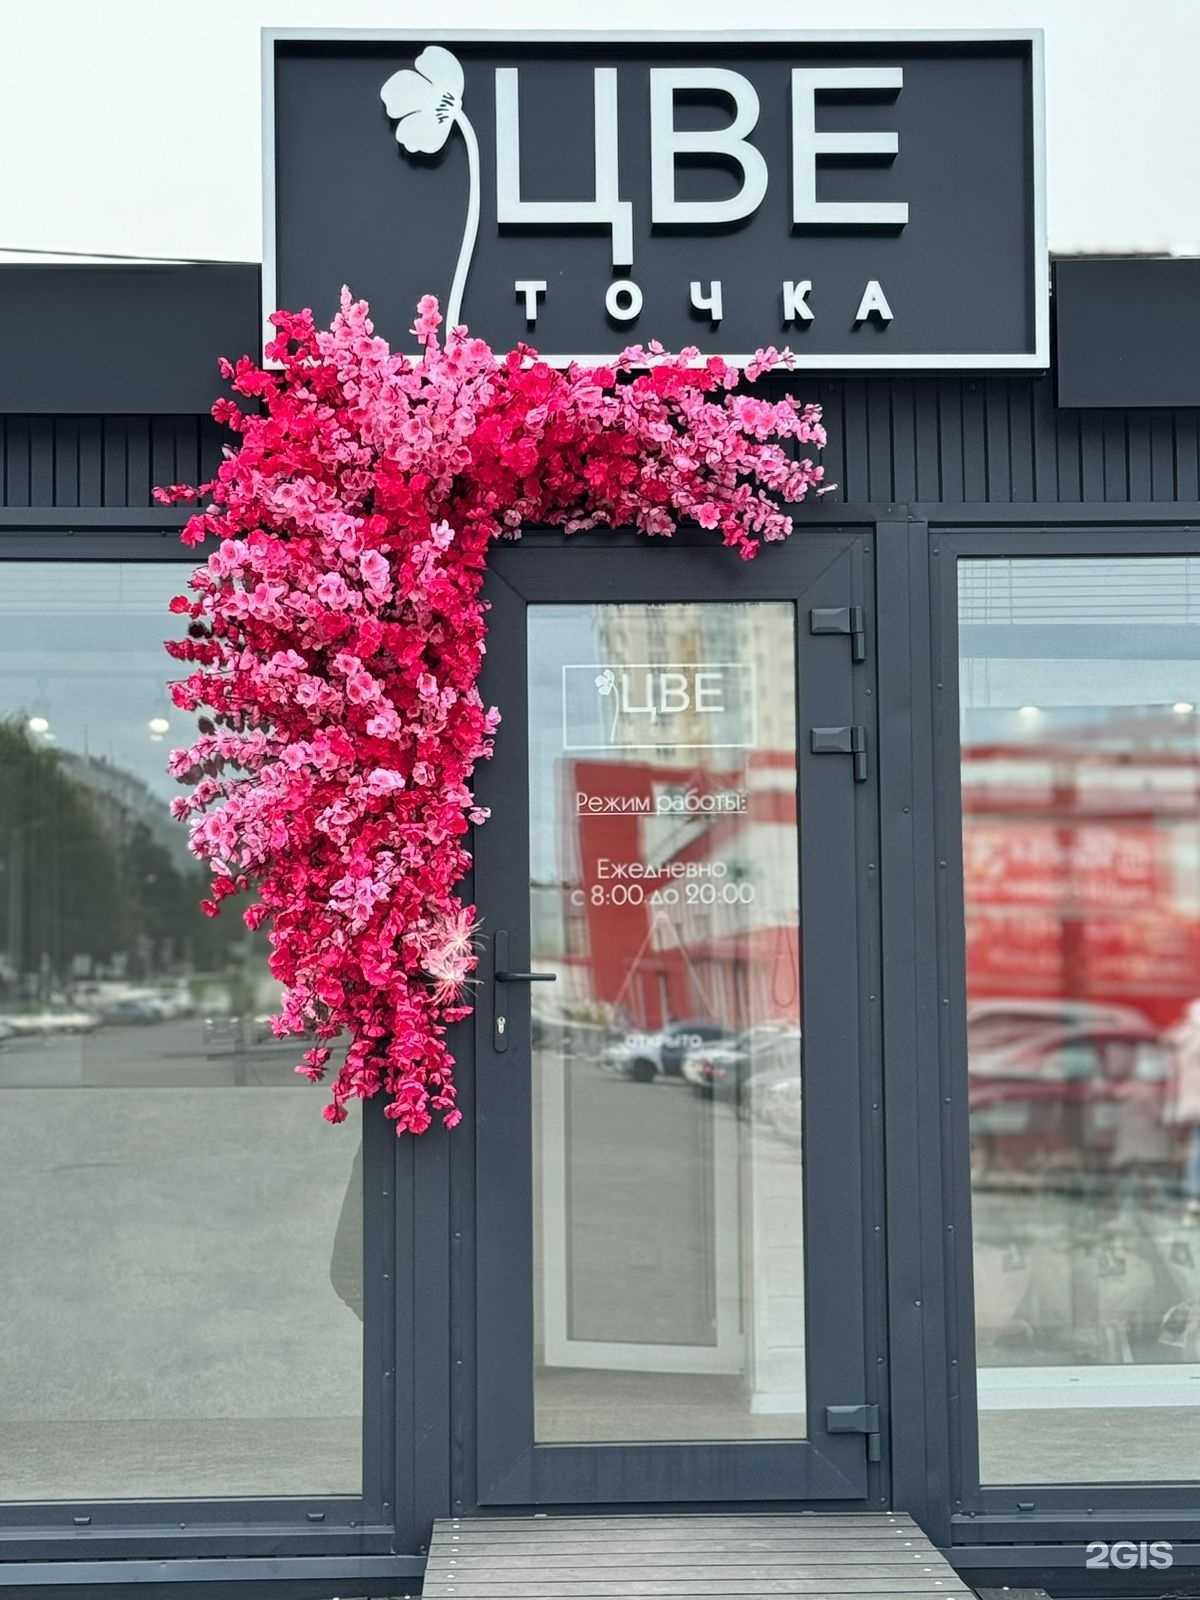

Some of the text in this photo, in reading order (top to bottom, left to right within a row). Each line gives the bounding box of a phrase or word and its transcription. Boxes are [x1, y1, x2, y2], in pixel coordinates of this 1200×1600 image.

[496, 67, 909, 266] ЦВЕ
[515, 280, 894, 322] ТОЧКА
[622, 673, 725, 721] ЦВЕ
[576, 789, 747, 815] Режим работы:
[597, 859, 727, 879] Ежедневно
[571, 883, 755, 906] с 8:00 до 20:00
